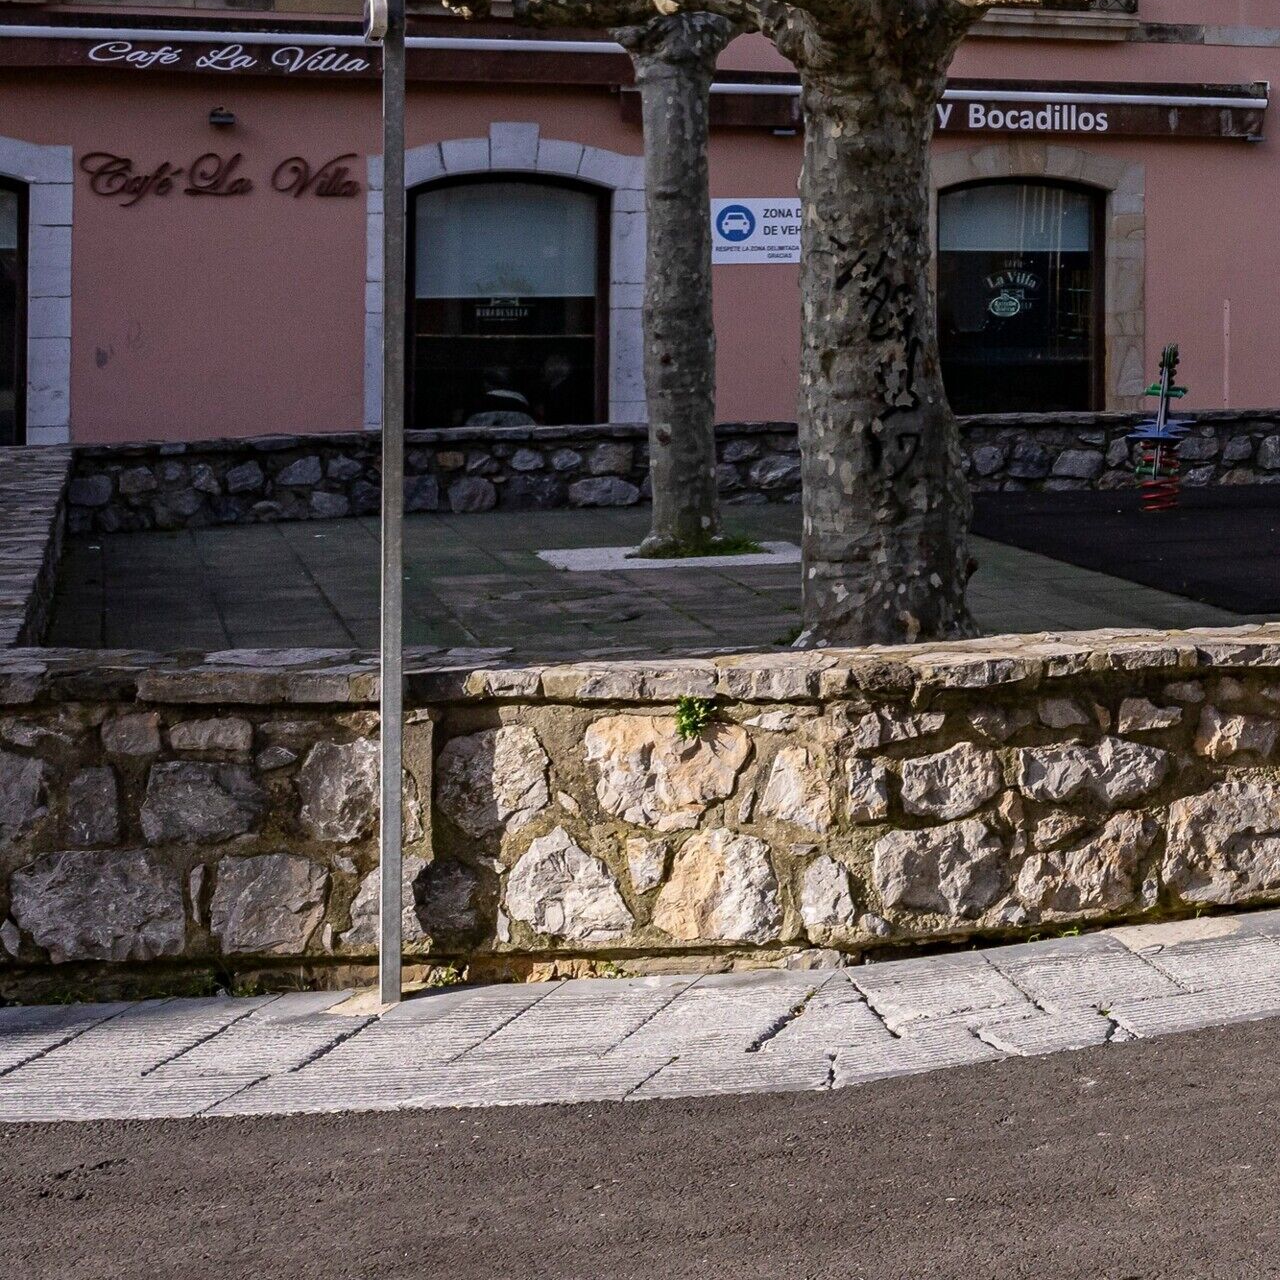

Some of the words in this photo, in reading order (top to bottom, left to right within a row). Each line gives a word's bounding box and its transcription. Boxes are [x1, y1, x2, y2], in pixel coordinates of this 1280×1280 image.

[88, 41, 182, 68] Café
[196, 44, 257, 70] La
[271, 46, 370, 72] Villa
[969, 103, 1108, 131] Bocadillos
[79, 152, 182, 207] Café
[184, 152, 253, 197] La
[271, 152, 361, 198] Villa
[763, 208, 793, 218] ZONA
[763, 225, 778, 236] DE
